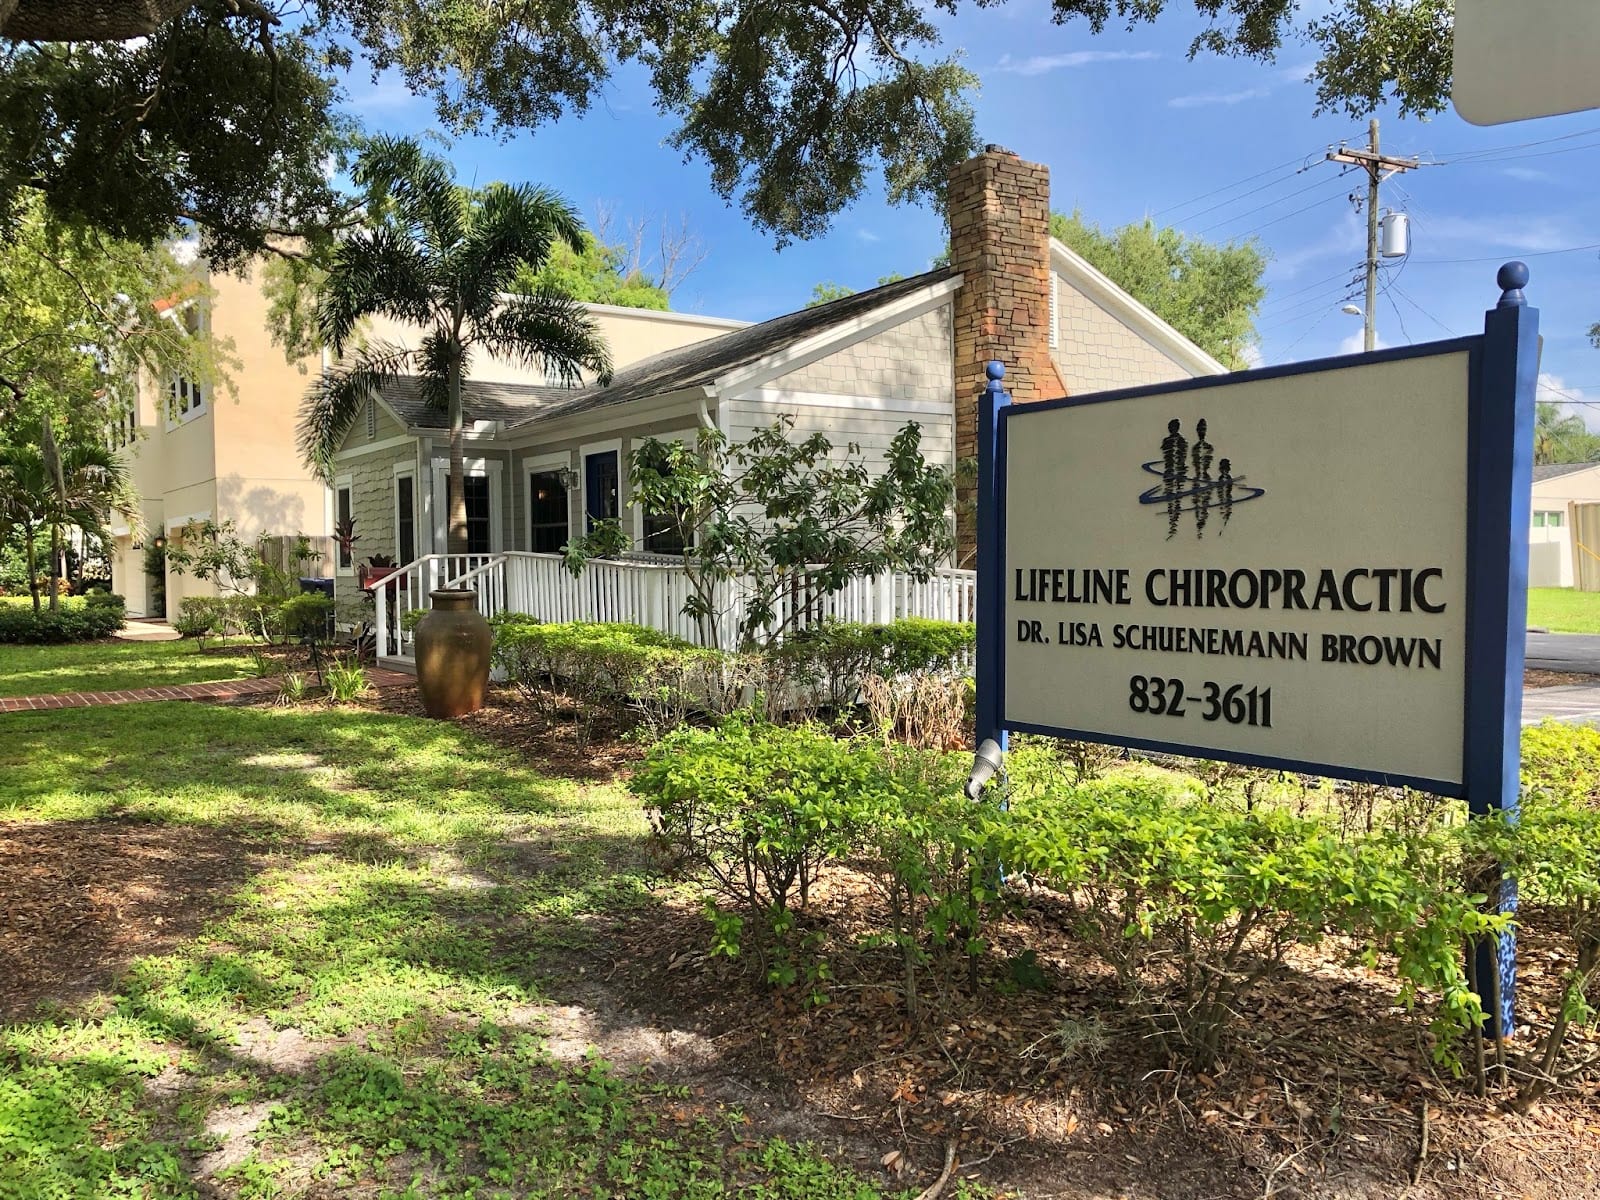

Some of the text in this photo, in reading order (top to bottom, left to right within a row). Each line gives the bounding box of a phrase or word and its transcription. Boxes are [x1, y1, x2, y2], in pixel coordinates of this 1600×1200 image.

[1015, 567, 1446, 614] LIFELINE CHIROPRACTIC
[1017, 619, 1442, 670] DR. LISA SCHUENEMANN BROWN
[1128, 674, 1272, 729] 832-3611
